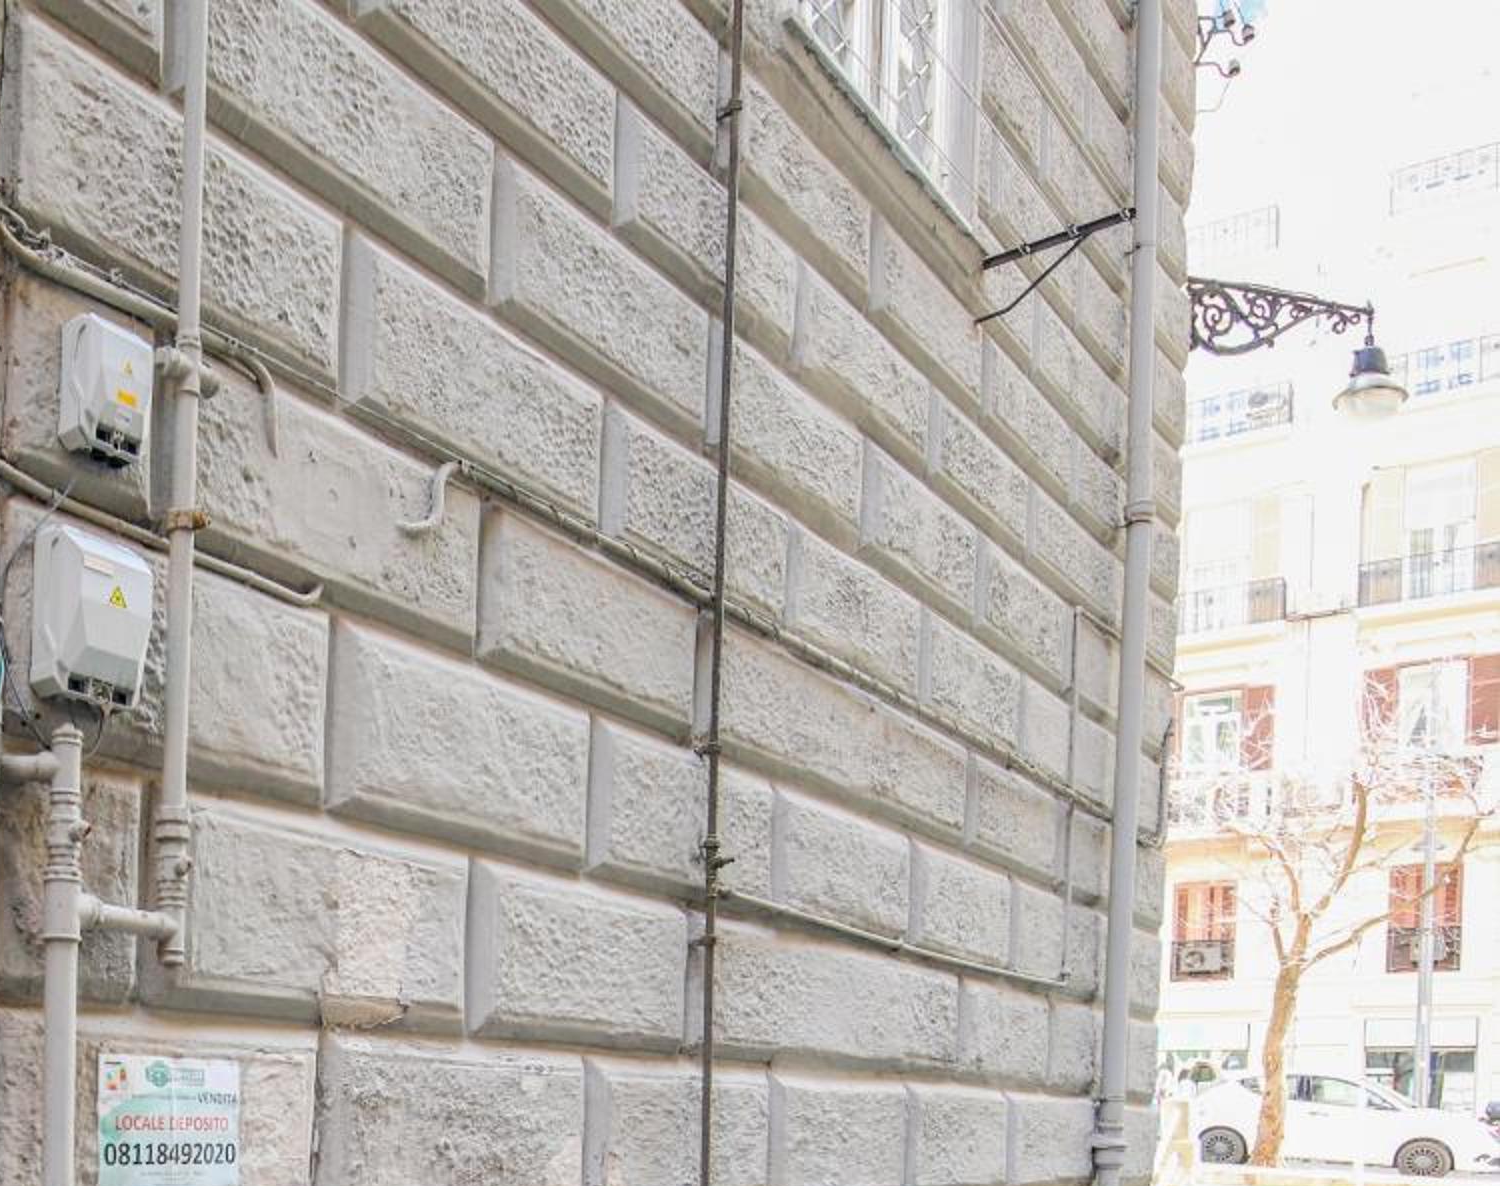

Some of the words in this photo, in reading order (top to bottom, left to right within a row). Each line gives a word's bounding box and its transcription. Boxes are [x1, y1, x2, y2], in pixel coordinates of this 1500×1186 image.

[197, 1092, 237, 1105] VENDITA
[115, 1115, 165, 1132] LOCALE
[169, 1116, 229, 1132] DEPOSITO
[103, 1142, 237, 1166] 08118492020
